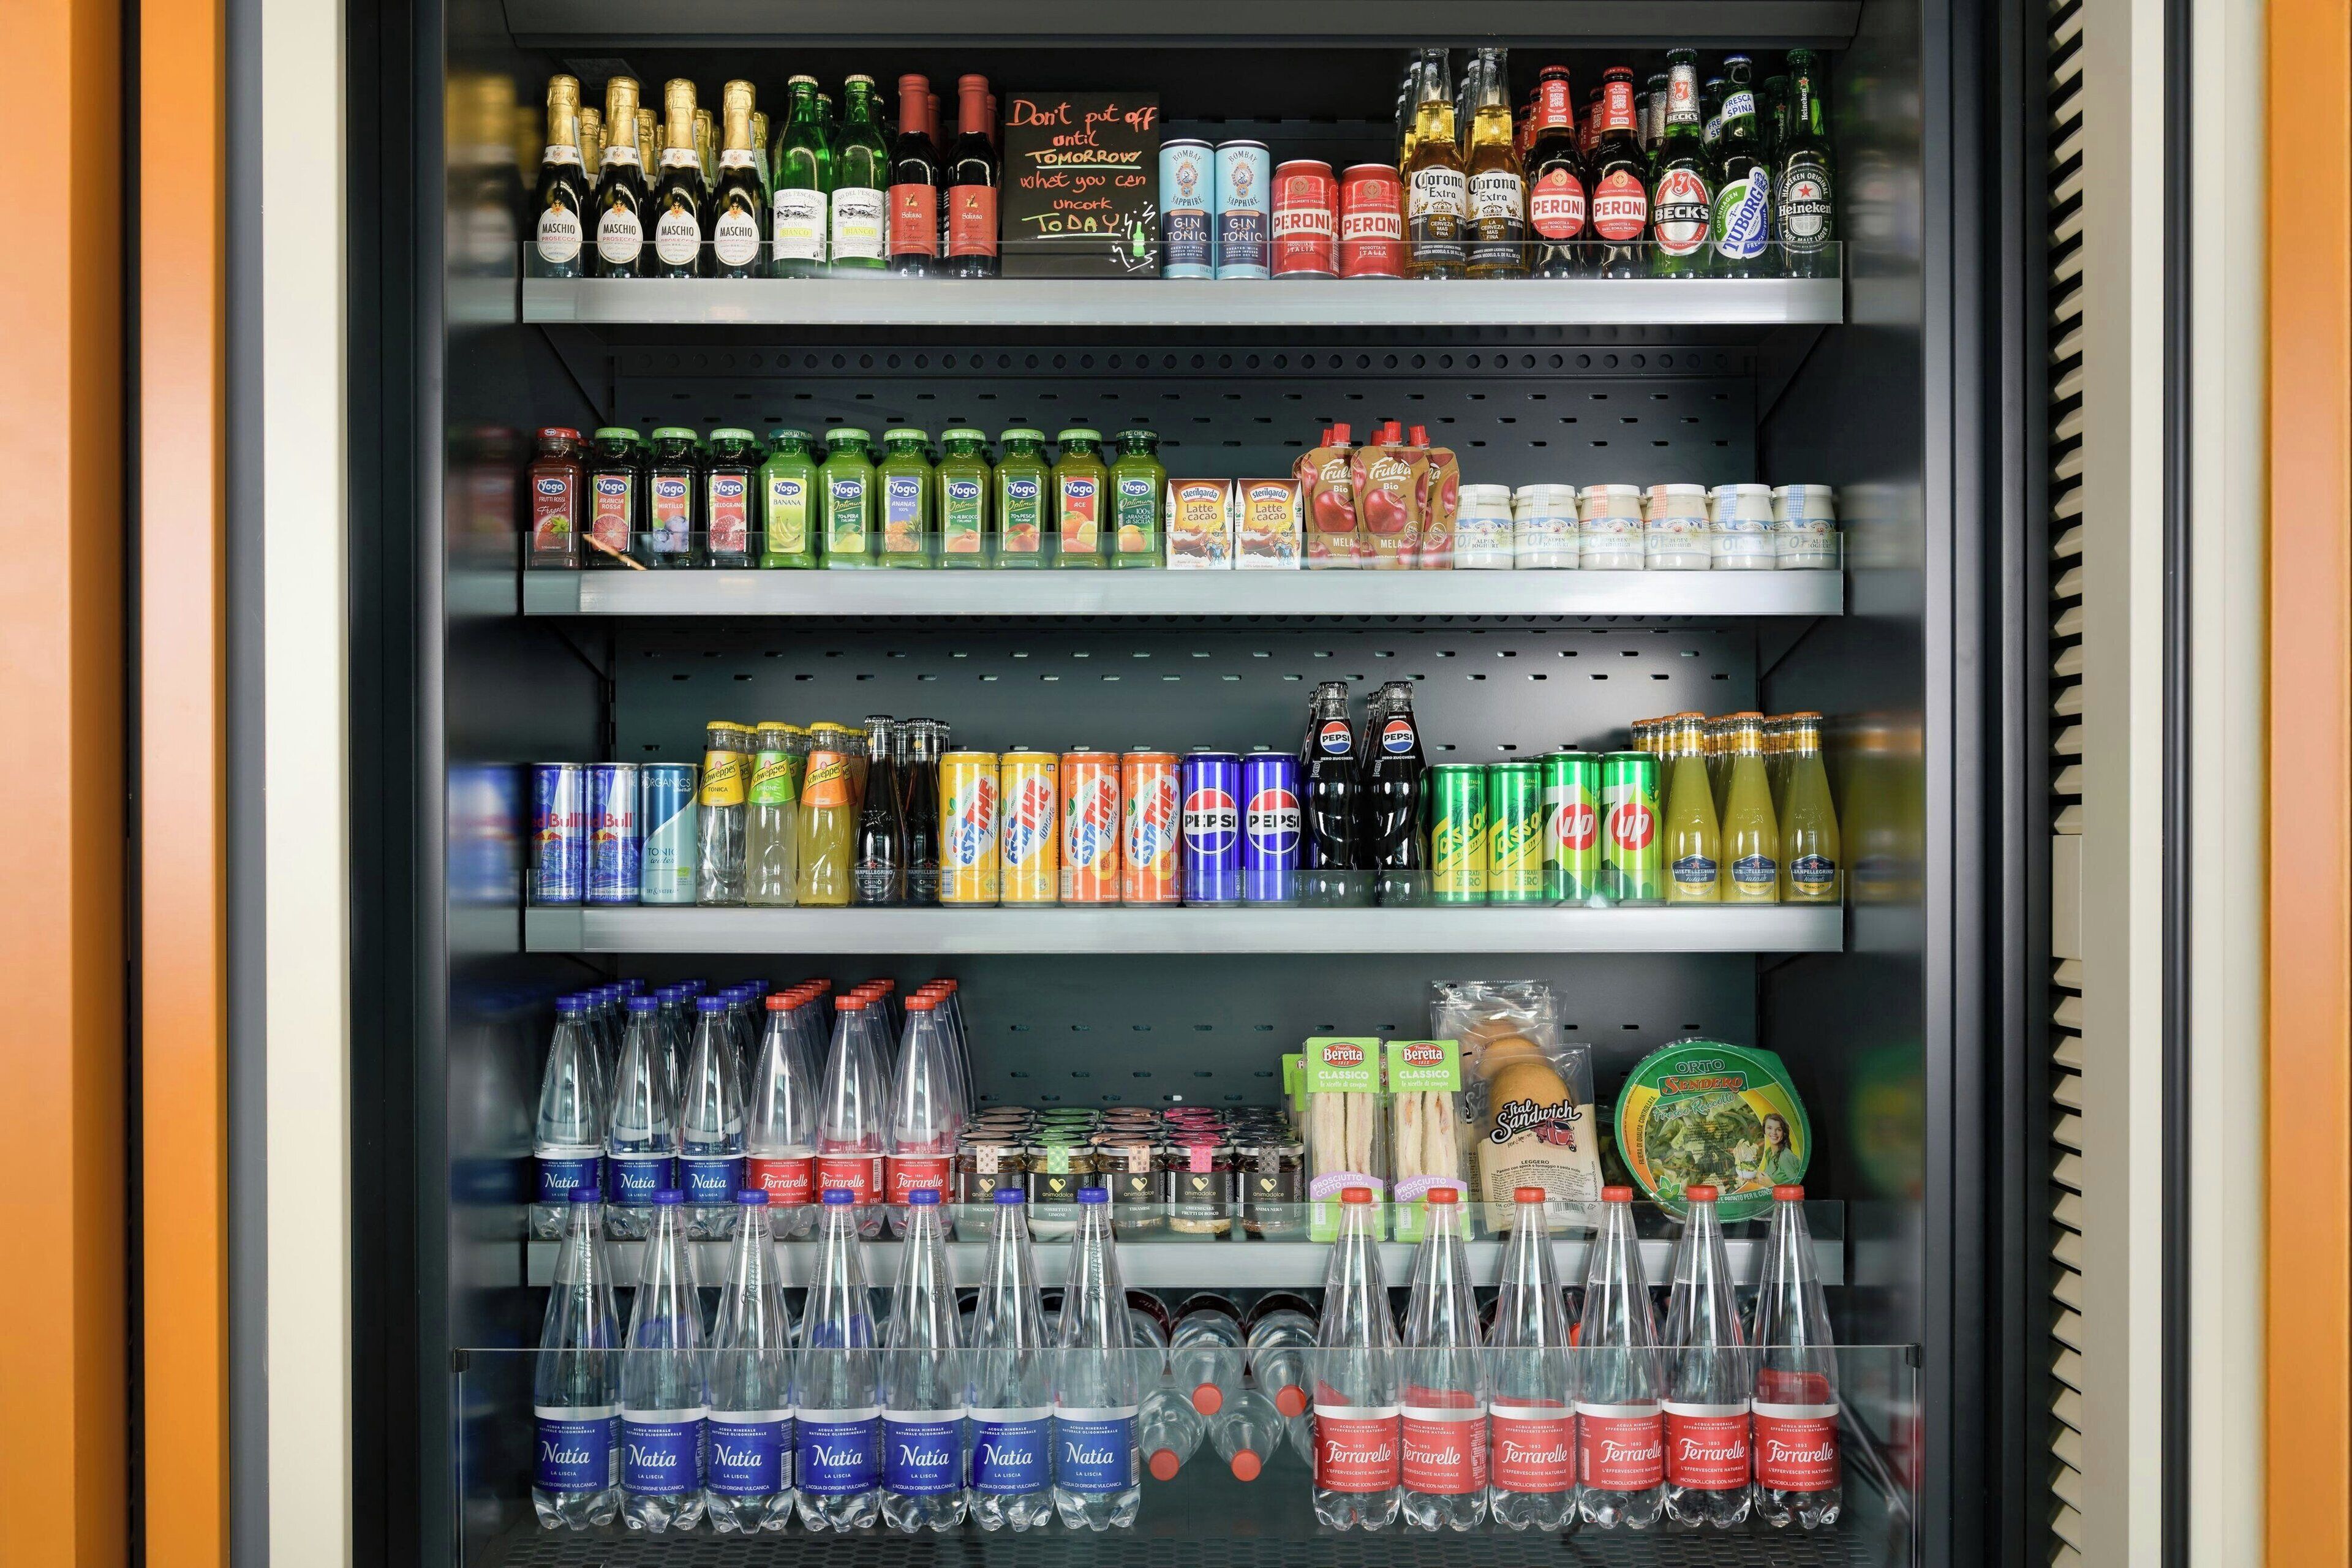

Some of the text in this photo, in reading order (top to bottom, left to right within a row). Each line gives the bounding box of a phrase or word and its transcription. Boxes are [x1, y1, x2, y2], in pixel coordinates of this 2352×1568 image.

[1725, 94, 1752, 109] FRESCA
[1005, 99, 1158, 135] Don't put off
[1667, 113, 1698, 122] BECK'S
[1727, 104, 1754, 118] SPINA
[1053, 130, 1099, 146] until
[1172, 149, 1202, 165] BOMBAY
[1228, 150, 1258, 165] BOMBAY
[1020, 171, 1071, 189] what
[1072, 175, 1106, 194] you
[1415, 172, 1463, 191] Corona
[1468, 176, 1517, 196] Corona
[1782, 173, 1828, 197] HEINEKEN ORIGINAL
[1171, 195, 1204, 206] SAPPHIRE
[1429, 187, 1456, 199] Extra
[1480, 190, 1507, 202] Extra
[1054, 197, 1112, 209] uncork
[1227, 195, 1260, 207] SAPPHIRE
[1533, 199, 1583, 215] PERONI
[1594, 200, 1645, 216] PERONI
[1654, 205, 1709, 222] BECK'S
[1717, 191, 1738, 233] COPENHAGEN
[1779, 202, 1831, 216] Heineken
[1174, 217, 1200, 228] GIN
[1230, 219, 1256, 228] GIN
[1273, 213, 1330, 232] PERONI
[1344, 217, 1400, 235] PERONI
[1723, 187, 1763, 251] TUBORG
[542, 224, 575, 234] MASCHIO
[603, 224, 636, 235] MASCHIO
[662, 225, 694, 236] MASCHIO
[720, 227, 752, 237] MASCHIO
[1167, 232, 1207, 241] TONIC
[1223, 232, 1262, 241] TONIC
[541, 480, 563, 492] Yoga
[599, 480, 624, 494] Yoga
[658, 483, 684, 496] Yoga
[716, 482, 741, 495] Yoga
[777, 483, 799, 495] Yoga
[834, 483, 860, 496] Yoga
[891, 483, 916, 496] Yoga
[951, 484, 977, 497] Yoga
[1009, 483, 1035, 496] Yoga
[1066, 483, 1093, 496] Yoga
[1123, 482, 1147, 494] Yoga
[1183, 488, 1217, 501] sterilgarda
[1252, 488, 1286, 501] sterilgarda
[537, 503, 567, 515] Fragola
[1187, 504, 1213, 513] Latte
[1256, 504, 1283, 513] Latte
[1333, 538, 1354, 547] MELA
[1381, 539, 1402, 548] MELA
[1322, 734, 1349, 742] PEPSI
[1384, 733, 1412, 742] PEPSI
[703, 764, 736, 784] Schweppes
[752, 764, 786, 784] Schweppes
[807, 765, 840, 784] Schweppes
[643, 777, 690, 788] ORGANICS
[586, 813, 633, 827] ed Bull
[1185, 814, 1236, 827] PEPSI
[1250, 815, 1300, 827] PEPSI
[1323, 1048, 1364, 1061] Beretta
[1403, 1048, 1443, 1060] Beretta
[1675, 1059, 1725, 1073] ORTO
[1318, 1071, 1369, 1079] CLASSICO
[1400, 1070, 1450, 1079] CLASSICO
[1661, 1076, 1743, 1095] SENDERO
[1508, 1100, 1532, 1117] Ital
[1638, 1096, 1656, 1123] CONTROLLATA
[1691, 1093, 1736, 1115] Raccolto
[1491, 1101, 1582, 1143] Sandwich
[545, 1173, 579, 1188] Natía
[620, 1173, 656, 1189] Natía
[692, 1174, 726, 1189] Natía
[761, 1173, 808, 1189] Ferrarelle
[820, 1172, 865, 1188] Ferrarelle
[896, 1172, 943, 1188] Ferrarelle
[1313, 1174, 1362, 1191] PROSCIUTTO
[1397, 1178, 1446, 1195] PROSCIUTTO
[1401, 1186, 1426, 1201] COTTO
[541, 1441, 590, 1464] Natía
[628, 1444, 677, 1467] Natía
[714, 1443, 762, 1467] Natía
[812, 1445, 862, 1466] Natía
[899, 1444, 949, 1466] Natía
[982, 1444, 1033, 1466] Natía
[1065, 1441, 1114, 1464] Natía
[1325, 1440, 1391, 1463] Ferrarelle
[1403, 1439, 1461, 1465] Ferrarelle
[1502, 1440, 1567, 1464] Ferrarelle
[1600, 1440, 1661, 1463] Ferrarelle
[1679, 1438, 1745, 1461] Ferrarelle
[1766, 1439, 1833, 1463] Ferrarelle
